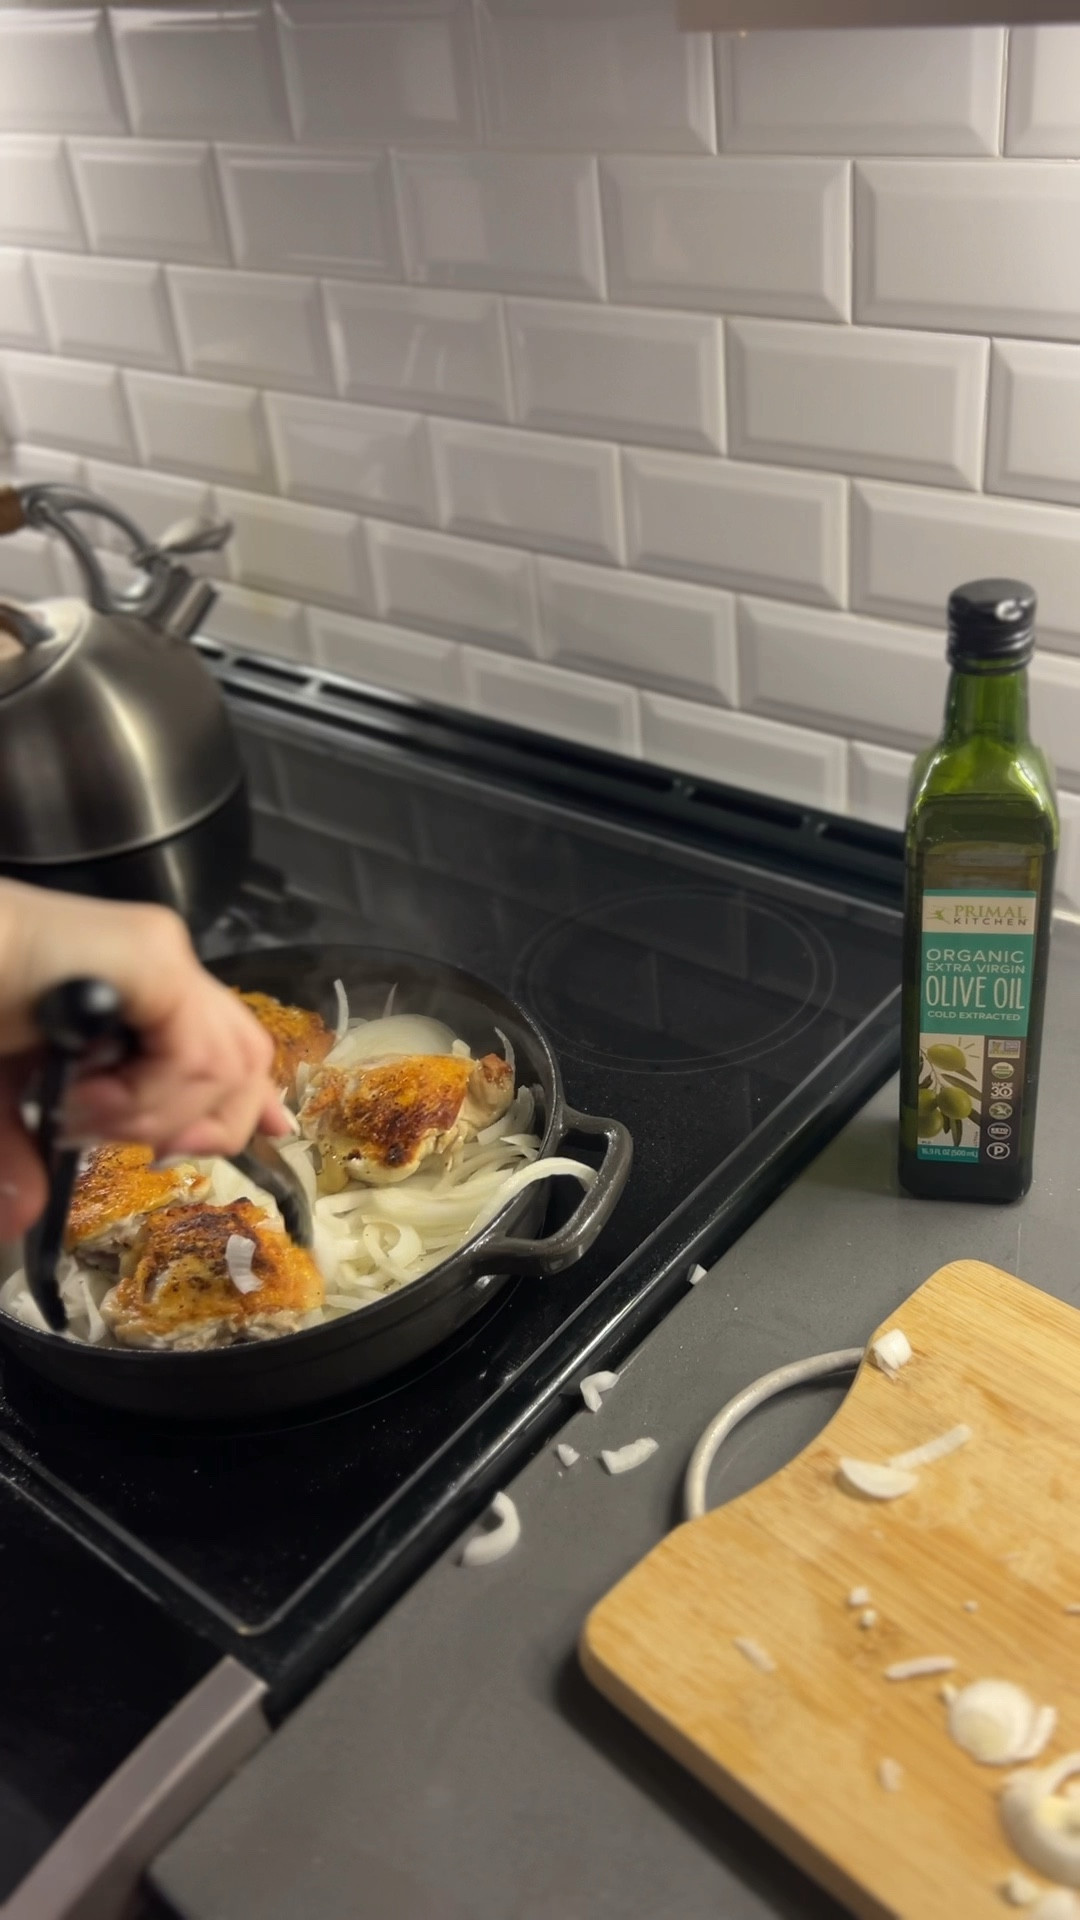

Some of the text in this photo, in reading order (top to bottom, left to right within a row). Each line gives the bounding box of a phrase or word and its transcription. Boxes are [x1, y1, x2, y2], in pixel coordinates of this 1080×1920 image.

[954, 905, 1026, 918] PRIMAL
[953, 918, 1028, 926] KITCHEN
[926, 949, 1024, 963] ORGANIC
[926, 963, 1025, 974] EXTRA VIRGIN
[926, 975, 1025, 1010] OLIVE OIL
[927, 1010, 1020, 1021] COLD EXTRACTED
